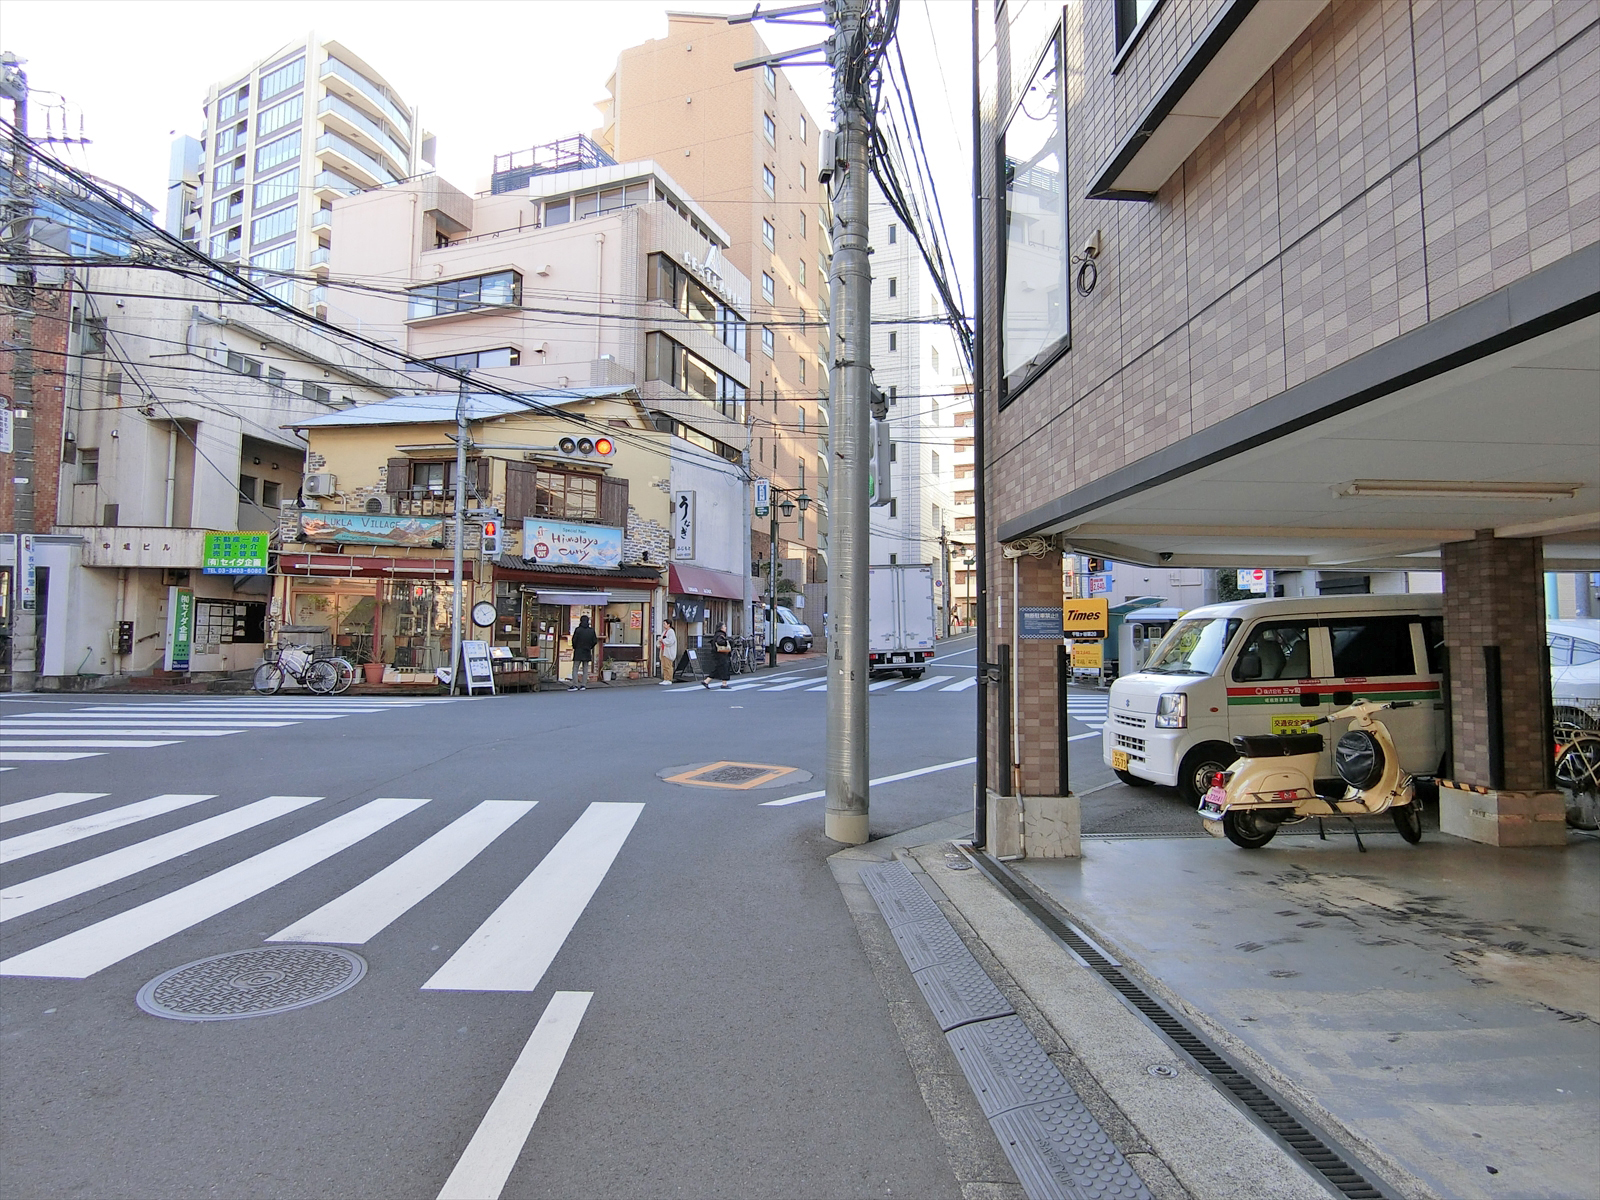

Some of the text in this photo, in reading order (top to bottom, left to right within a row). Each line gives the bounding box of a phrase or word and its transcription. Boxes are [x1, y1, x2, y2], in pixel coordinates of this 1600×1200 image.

[679, 495, 691, 540] うなぎ
[551, 533, 598, 549] Himalaya
[558, 548, 590, 562] Curry
[1067, 609, 1101, 621] Times
[1039, 1139, 1075, 1188] SAFETYUP
